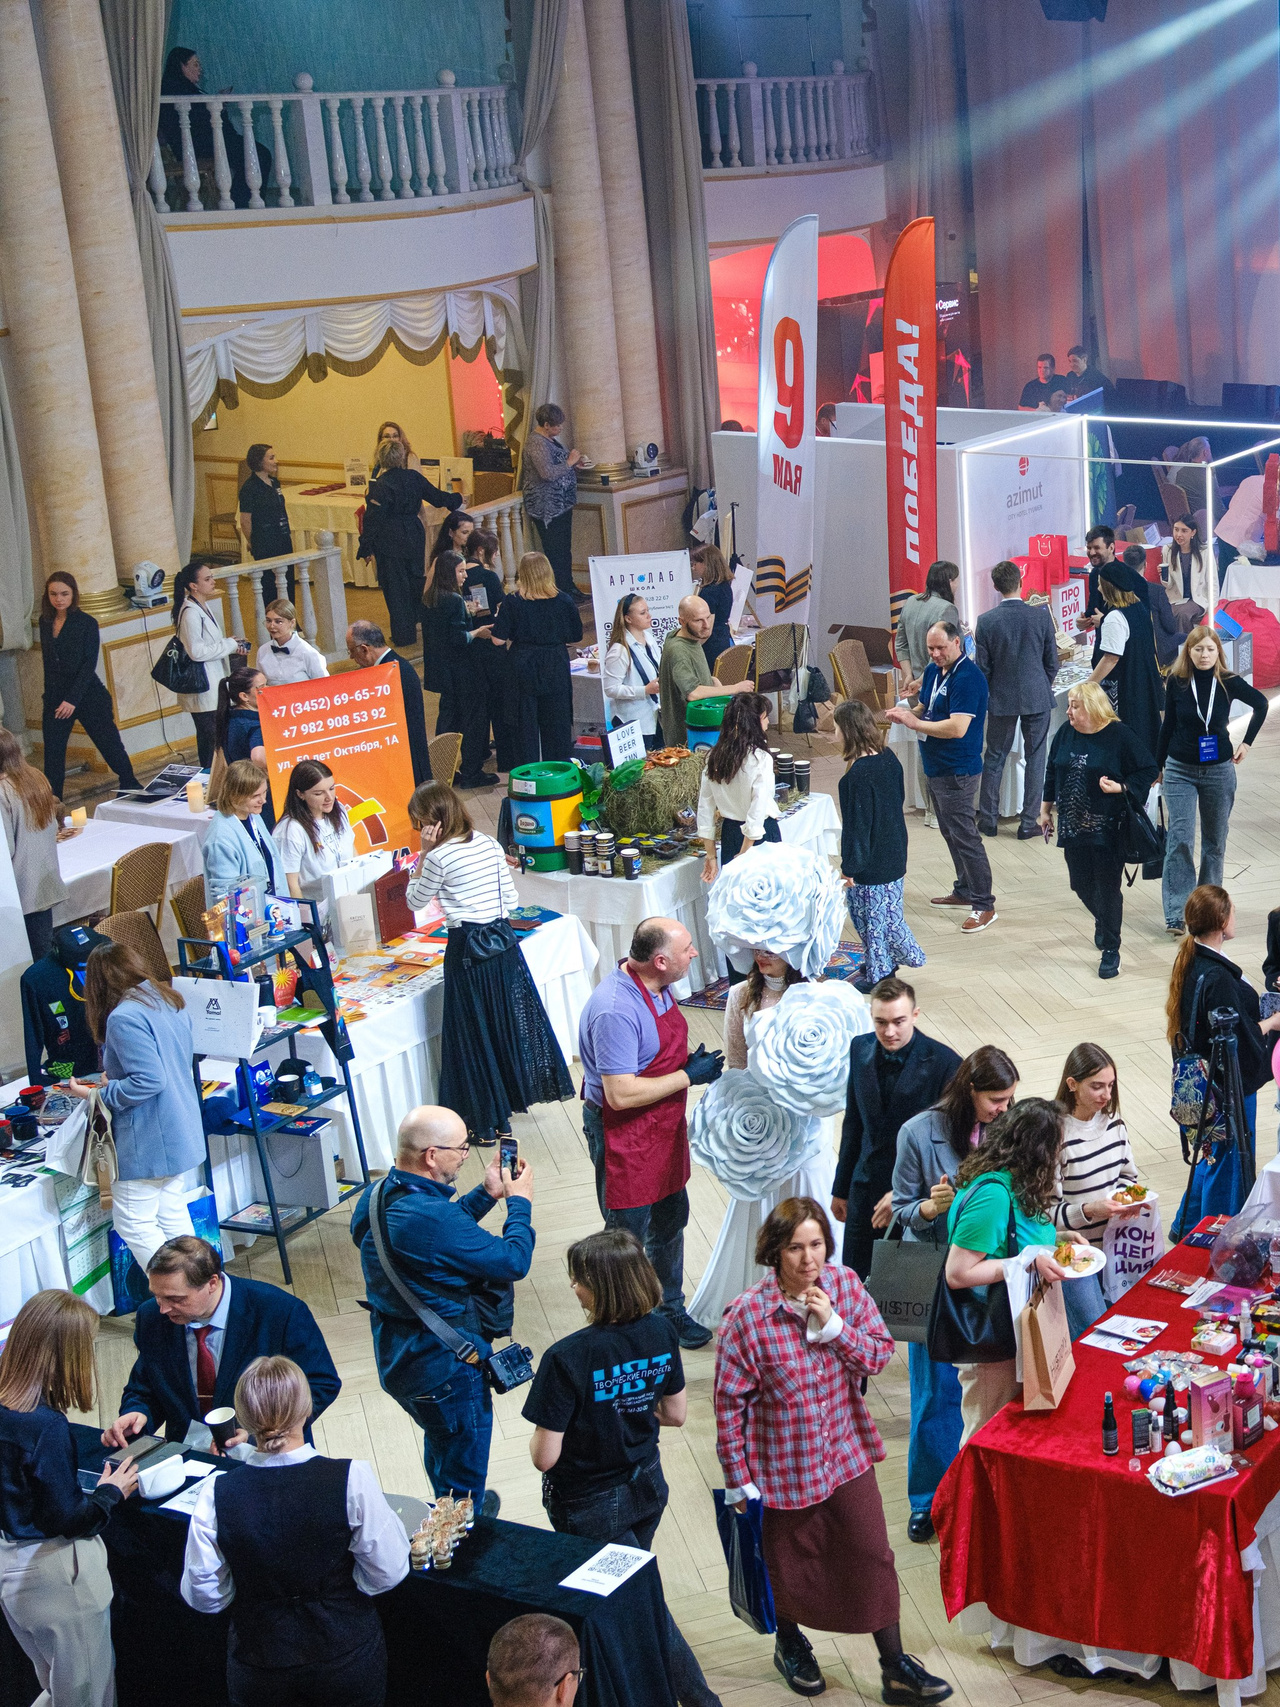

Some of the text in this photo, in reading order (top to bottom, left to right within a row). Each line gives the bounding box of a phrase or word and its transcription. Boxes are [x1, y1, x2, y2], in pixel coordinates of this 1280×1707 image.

[773, 316, 805, 449] 9
[896, 319, 920, 565] ПОБЕДА!
[773, 453, 803, 497] МАЯ
[1006, 481, 1043, 508] azimut
[1061, 586, 1080, 603] ПРО
[1061, 599, 1080, 618] БУЙ
[1063, 618, 1074, 633] ТЕ
[272, 684, 391, 718] +7 (3452) 69-65-70
[282, 707, 387, 739] +7 982 908 53 92
[616, 726, 635, 741] LOVE
[277, 760, 294, 773] ул.
[334, 740, 383, 758] Октября,
[384, 734, 399, 746] 1А
[618, 739, 637, 754] BEER
[1115, 1226, 1155, 1244] КОН
[1114, 1243, 1154, 1259] ЦЕП
[1115, 1259, 1155, 1275] ЦИЯ
[594, 1371, 640, 1390] ТВОРЧЕСКИЕ
